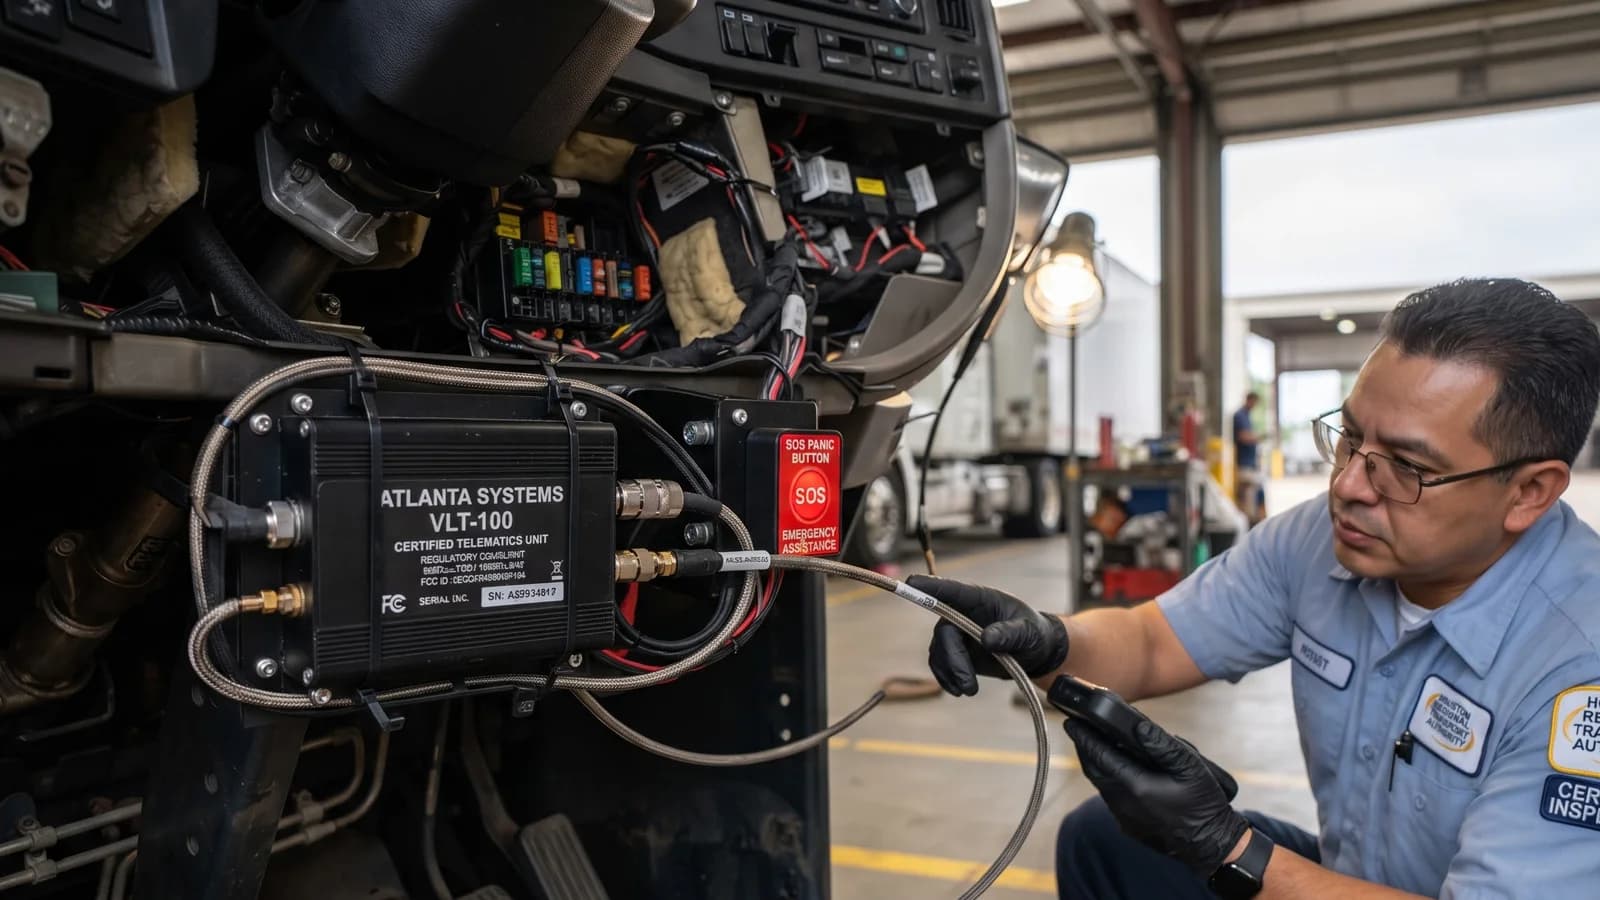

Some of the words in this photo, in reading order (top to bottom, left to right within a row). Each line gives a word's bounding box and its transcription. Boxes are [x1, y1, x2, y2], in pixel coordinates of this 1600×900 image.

[786, 439, 805, 450] SOS
[808, 439, 835, 450] PANIC
[792, 453, 830, 464] BUTTON
[381, 488, 472, 507] ATLANTA
[477, 485, 564, 505] SYSTEMS
[795, 487, 826, 505] SOS
[429, 511, 513, 532] VLT-100
[782, 527, 837, 540] EMERGENCY
[394, 539, 454, 552] CERTIFIED
[456, 535, 522, 549] TELEMATICS
[525, 534, 549, 545] UNIT
[782, 540, 837, 554] ASSISTANCE
[420, 553, 477, 564] REGULATORY
[420, 576, 438, 586] FCC
[440, 576, 449, 585] ID
[419, 595, 450, 606] SERIAL
[1587, 696, 1600, 709] H
[1558, 781, 1600, 805] CER
